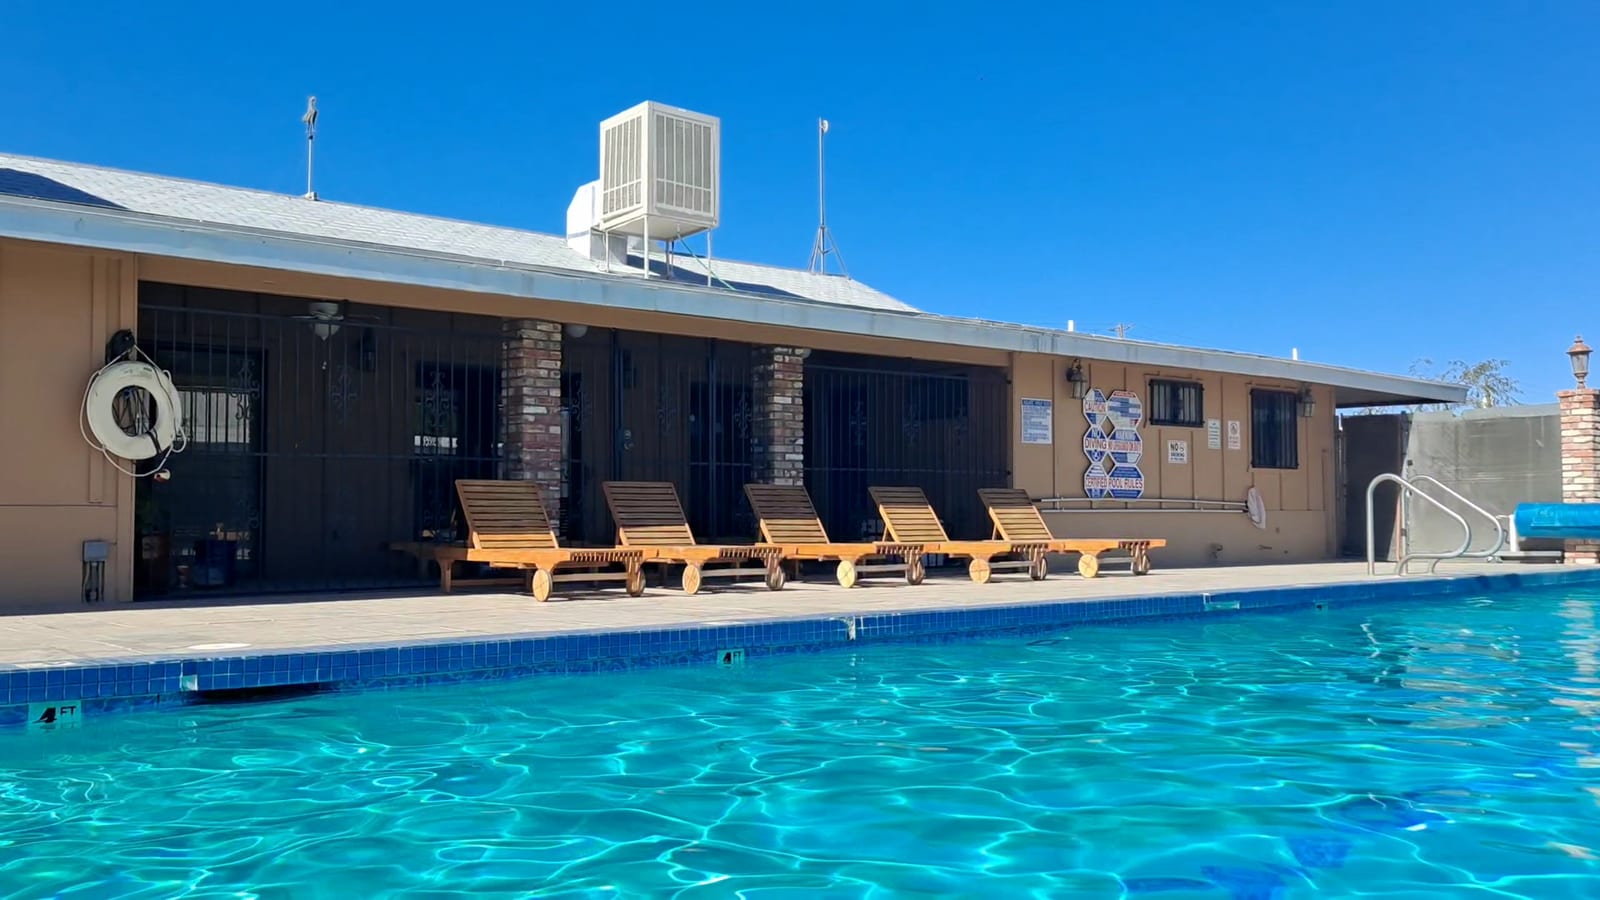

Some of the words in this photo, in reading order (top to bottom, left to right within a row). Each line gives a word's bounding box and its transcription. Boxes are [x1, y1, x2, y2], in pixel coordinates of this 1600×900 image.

[1085, 401, 1106, 412] CAUTION
[1091, 428, 1101, 439] NO
[1085, 439, 1107, 450] DIVING
[1170, 443, 1179, 451] NO
[1108, 478, 1123, 488] POOL
[1124, 478, 1143, 489] RULES
[723, 651, 732, 664] 4
[32, 707, 57, 724] 4
[60, 705, 77, 716] FT
